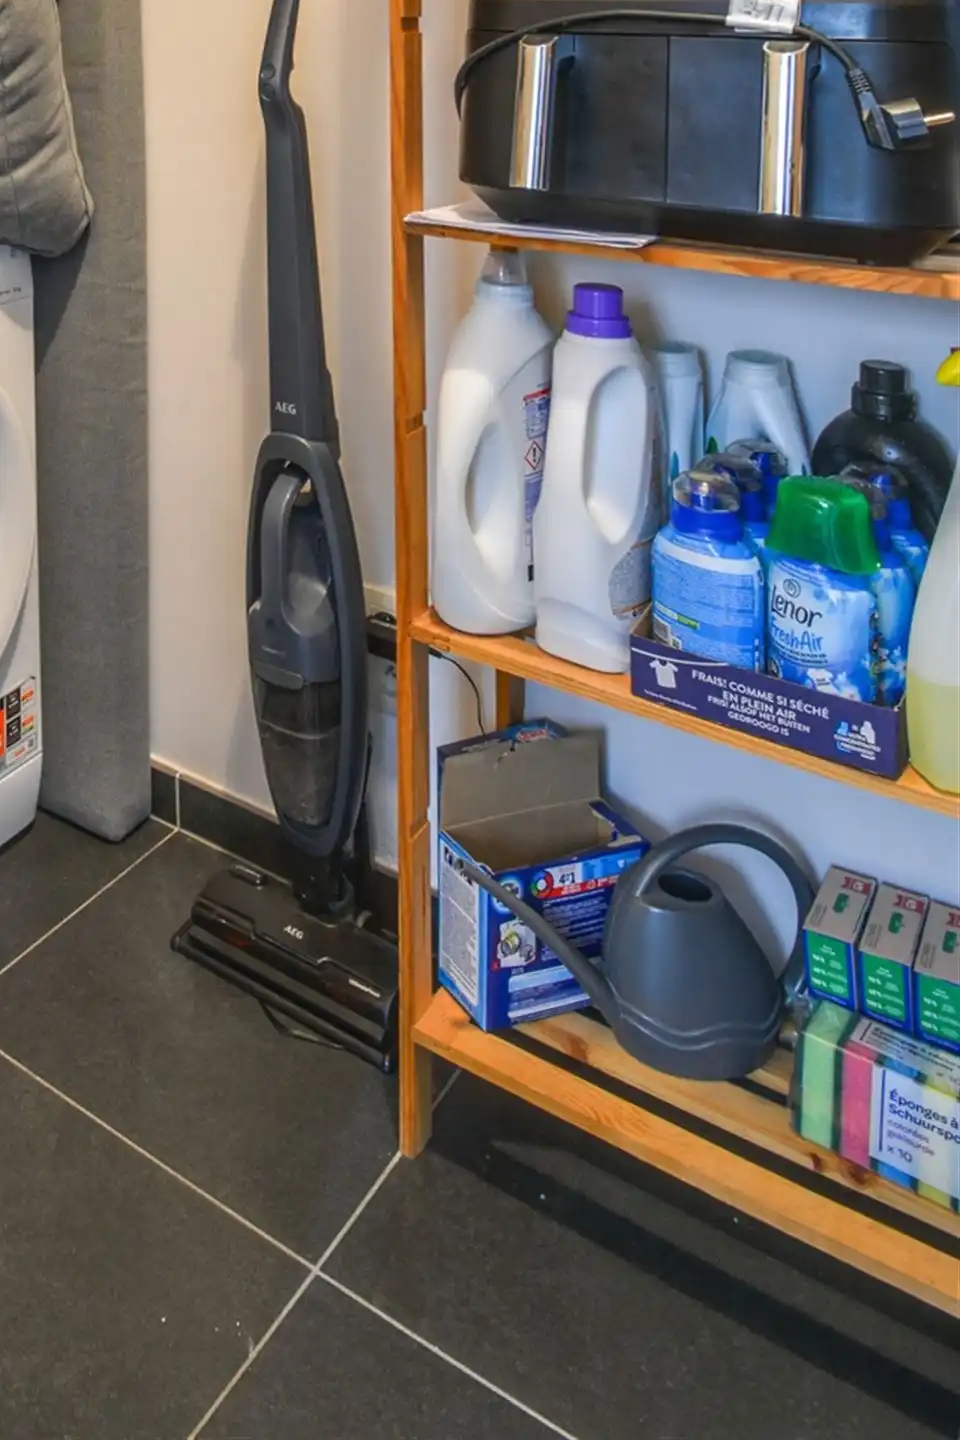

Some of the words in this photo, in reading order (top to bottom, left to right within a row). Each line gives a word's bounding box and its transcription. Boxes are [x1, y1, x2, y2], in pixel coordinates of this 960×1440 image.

[275, 401, 297, 416] AEG
[772, 584, 822, 627] Lenor
[691, 669, 727, 688] FRAIS!
[728, 680, 774, 704] COMME
[776, 694, 788, 707] SI
[789, 699, 830, 720] SÉCHÉ
[722, 690, 739, 703] EN
[740, 696, 774, 714] PLEIN
[776, 707, 797, 721] AIR
[283, 925, 304, 939] AEG
[889, 1087, 948, 1125] Éponges
[949, 1117, 959, 1129] à
